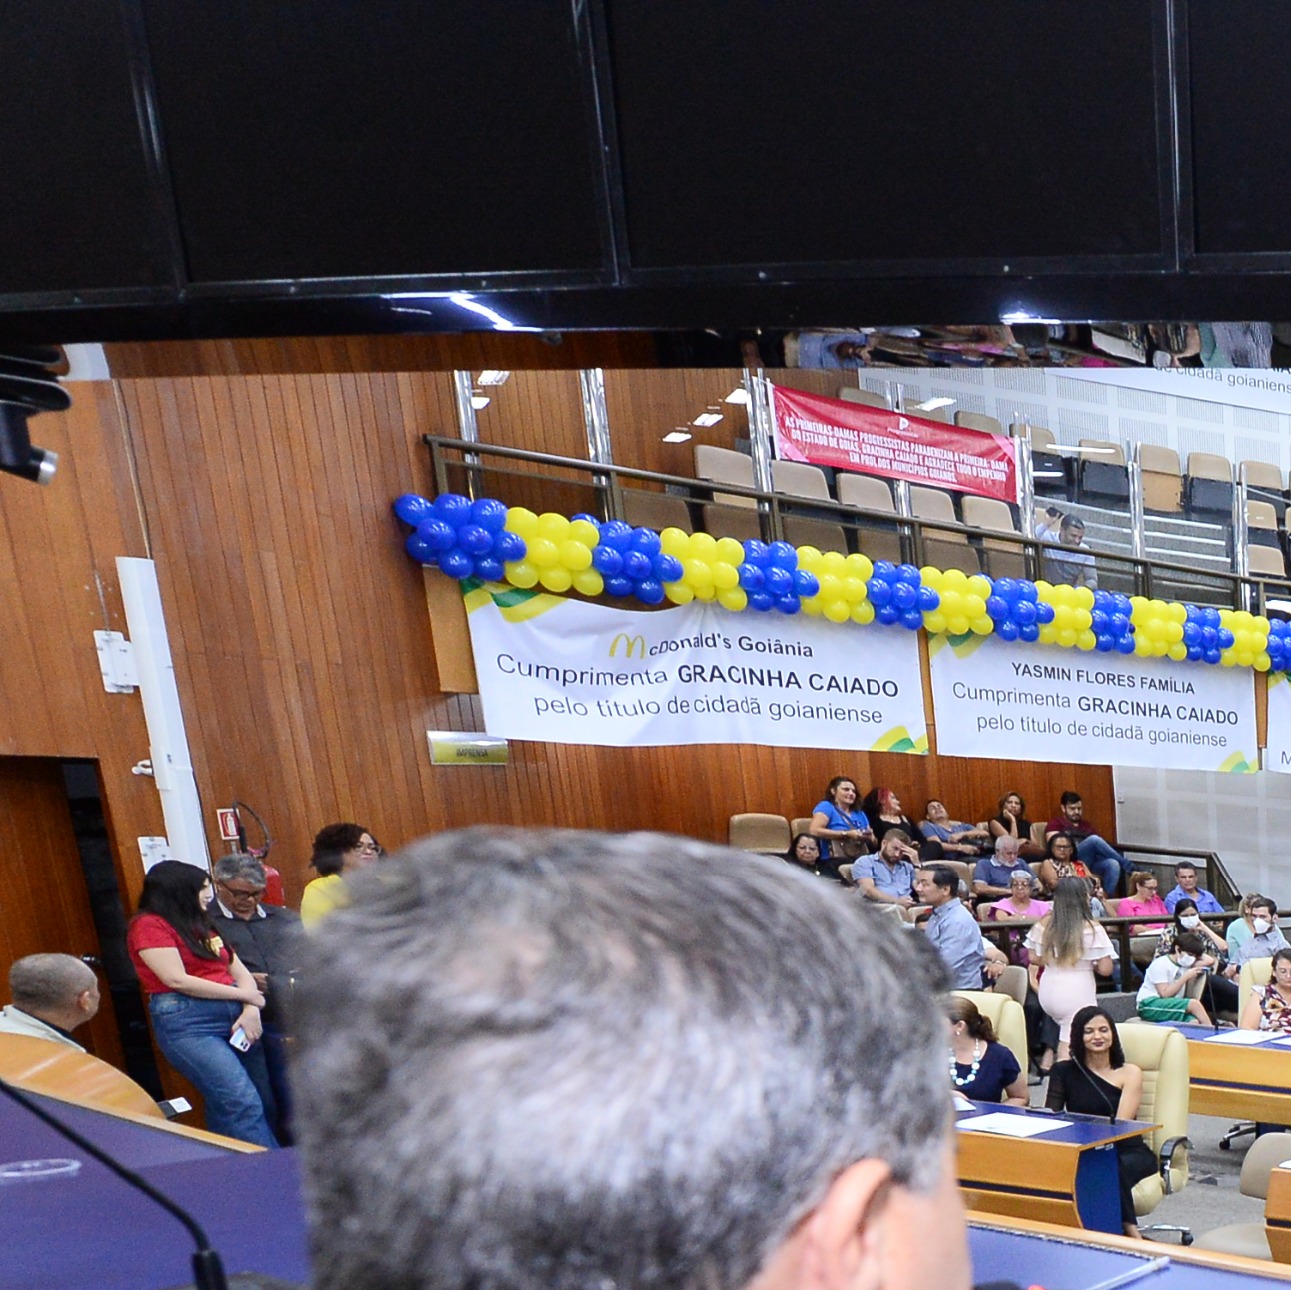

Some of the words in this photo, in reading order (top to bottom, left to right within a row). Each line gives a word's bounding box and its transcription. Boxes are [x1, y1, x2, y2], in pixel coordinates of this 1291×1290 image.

[785, 416, 796, 428] AS
[796, 417, 859, 441] PRIMEIRAS-DAMAS
[859, 431, 910, 451] PROGRESSISTAS
[910, 443, 953, 460] PARABENIZAM
[954, 452, 960, 462] A
[991, 460, 1009, 472] DAMA
[792, 429, 802, 440] DO
[802, 431, 828, 446] ESTADO
[829, 436, 838, 448] DE
[839, 438, 861, 453] GOIÁS,
[862, 443, 894, 460] GRACINHA
[894, 449, 918, 464] CAIADO
[920, 456, 924, 465] E
[925, 457, 955, 471] AGRADECE
[956, 463, 972, 475] TODO
[972, 466, 978, 476] O
[978, 468, 1006, 481] EMPENHO
[738, 636, 814, 658] Goiânia
[497, 653, 668, 687] Cumprimenta
[678, 665, 802, 690] GRACINHA
[809, 673, 899, 698] CAIADO
[1012, 662, 1072, 682] YASMIN
[1076, 670, 1136, 688] FLORES
[1140, 675, 1195, 695] FAMÍLIA
[534, 696, 588, 717] pelo
[667, 694, 690, 714] de
[694, 694, 762, 716] cidadã
[769, 700, 882, 724] goianiense
[952, 682, 1071, 710] Cumprimenta
[1078, 696, 1172, 720] GRACINHA
[1176, 706, 1239, 726] CAIADO
[976, 714, 1014, 733] pelo
[1020, 716, 1062, 736] título
[1067, 721, 1088, 737] de
[1092, 723, 1144, 740] cidadã
[1148, 728, 1227, 748] goianiense
